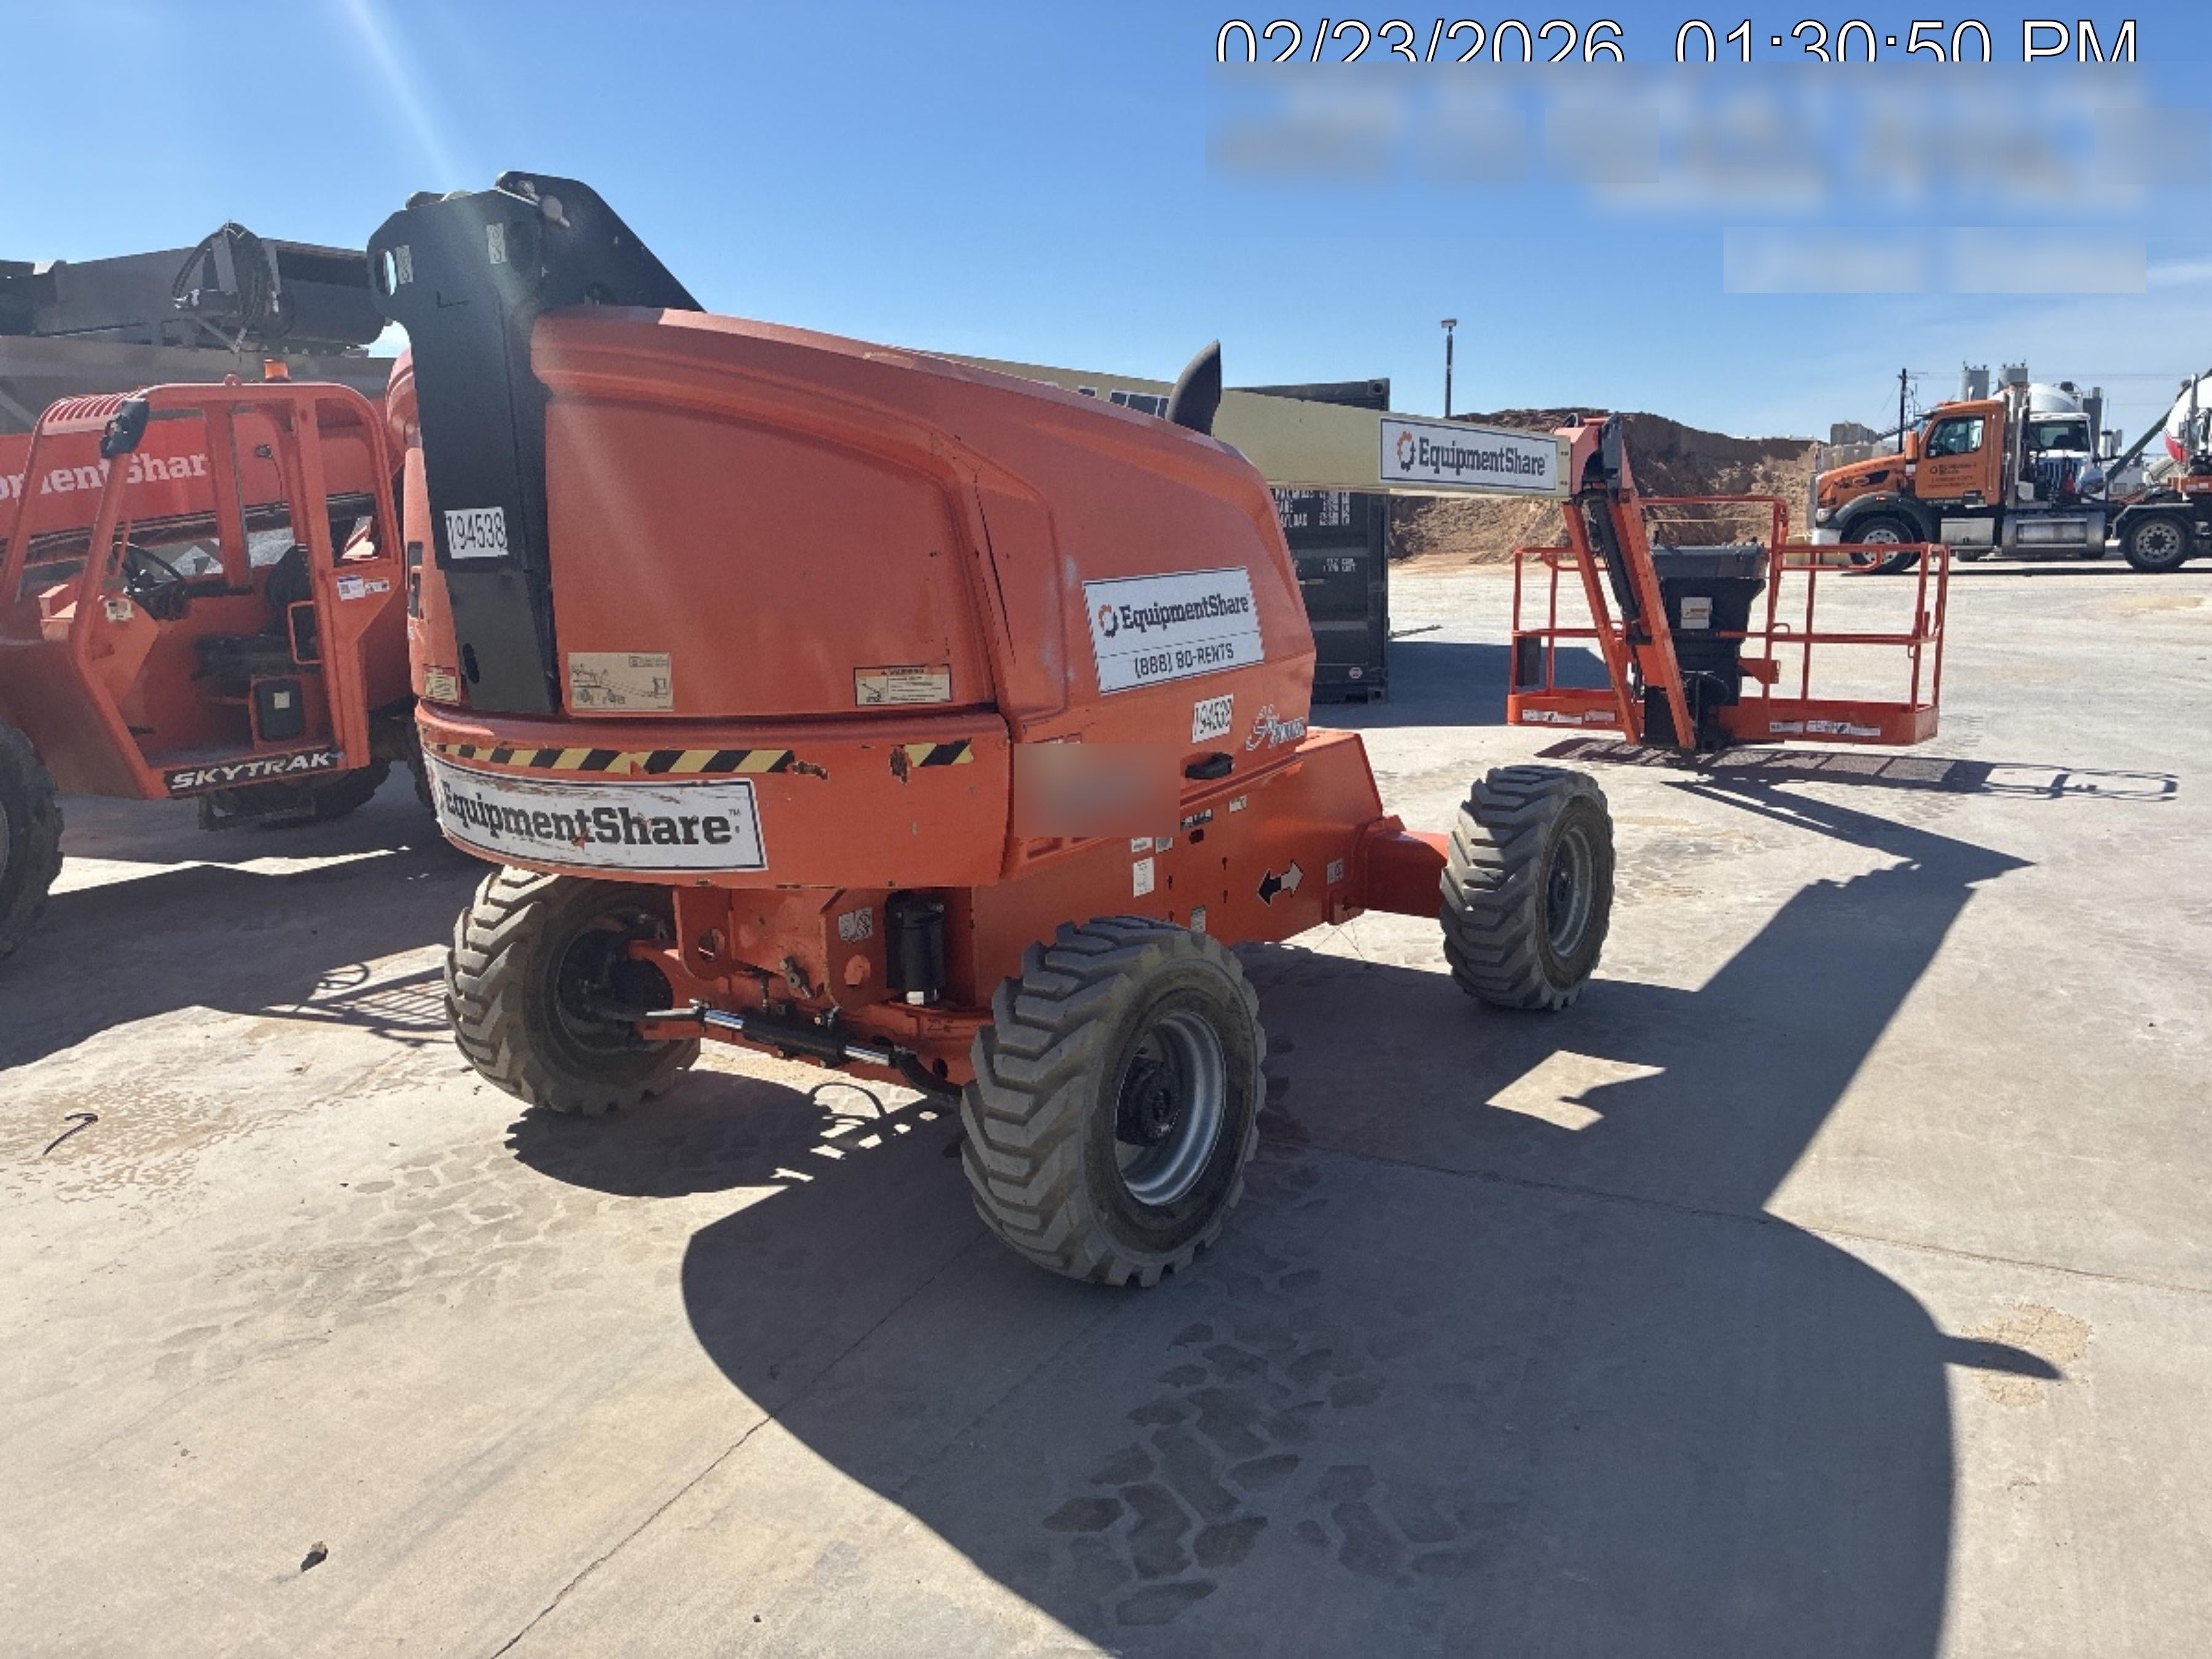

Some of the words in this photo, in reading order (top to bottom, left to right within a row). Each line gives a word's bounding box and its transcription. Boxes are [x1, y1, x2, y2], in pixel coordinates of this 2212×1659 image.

[446, 512, 506, 551] 194538
[1134, 651, 1173, 678] (888)
[1175, 643, 1234, 669] 80-RENTS
[171, 751, 331, 790] SKYTRAK
